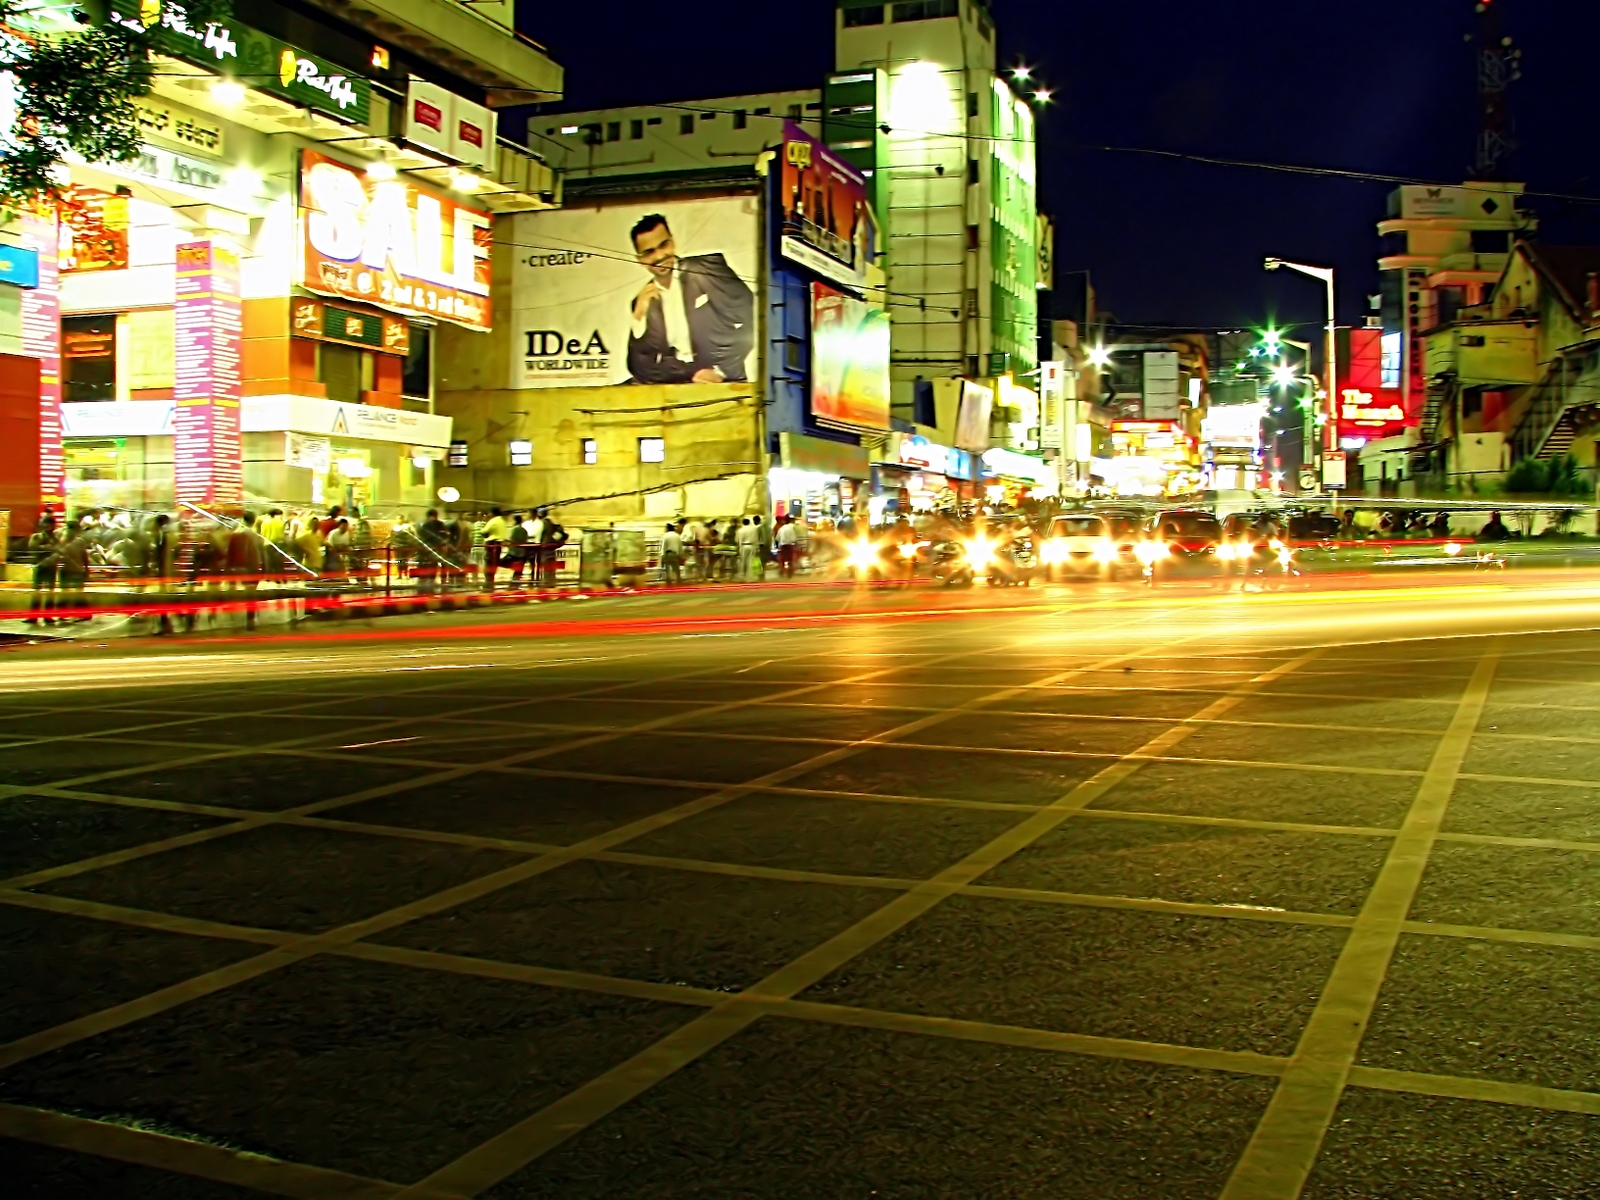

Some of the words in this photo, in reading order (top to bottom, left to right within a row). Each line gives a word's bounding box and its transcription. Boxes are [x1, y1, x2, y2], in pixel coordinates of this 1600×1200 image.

[309, 162, 490, 297] SALE
[525, 329, 609, 357] IDeA
[525, 359, 609, 371] WORLDWIDE
